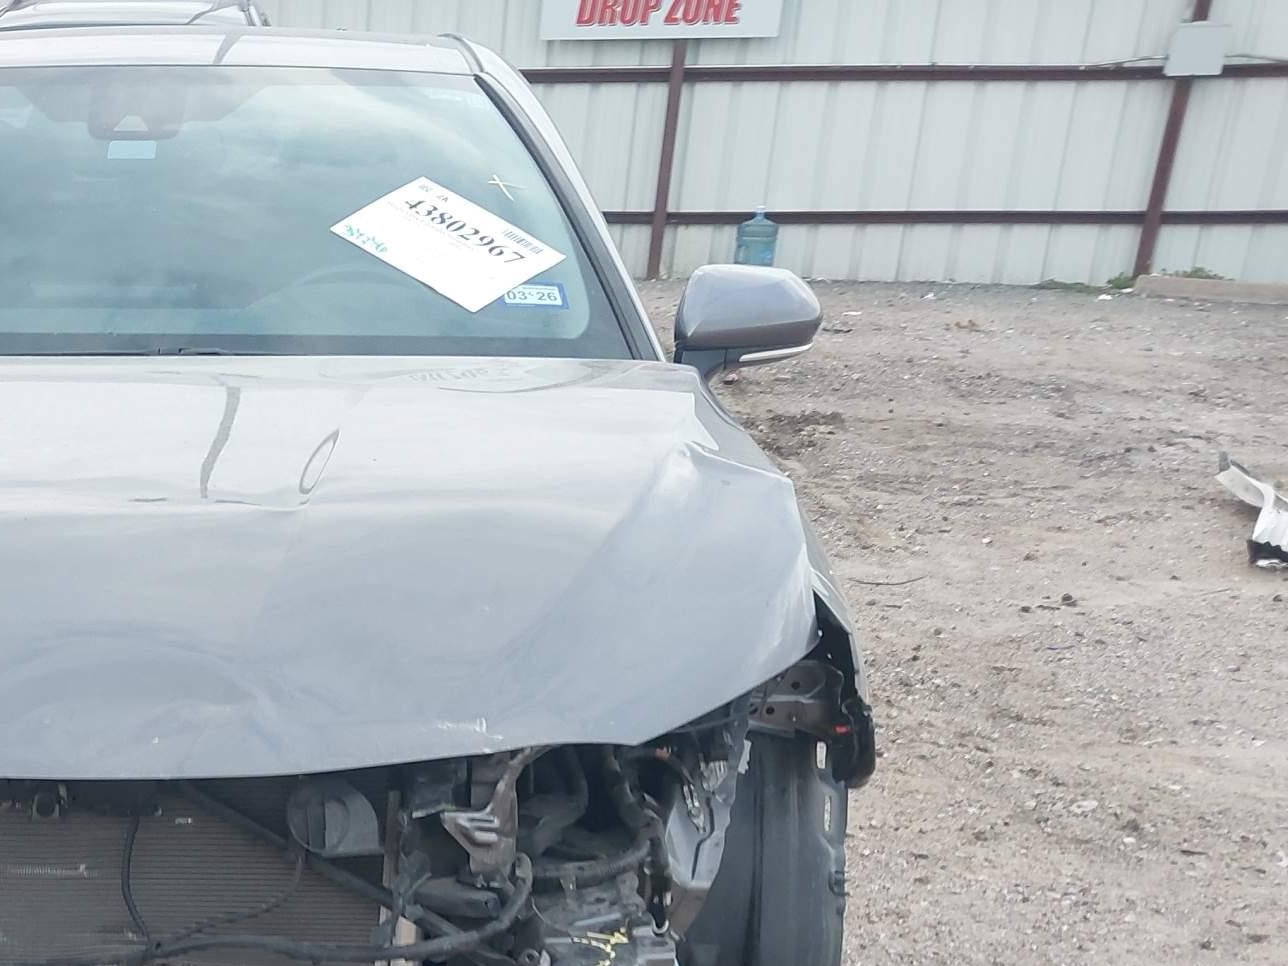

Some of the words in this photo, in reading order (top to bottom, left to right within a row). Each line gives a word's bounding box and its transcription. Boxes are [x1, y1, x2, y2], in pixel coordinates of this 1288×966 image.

[575, 0, 662, 26] DROP
[663, 0, 743, 25] ZONE
[404, 199, 527, 265] 43802967
[506, 290, 528, 301] 03
[535, 291, 558, 302] 26
